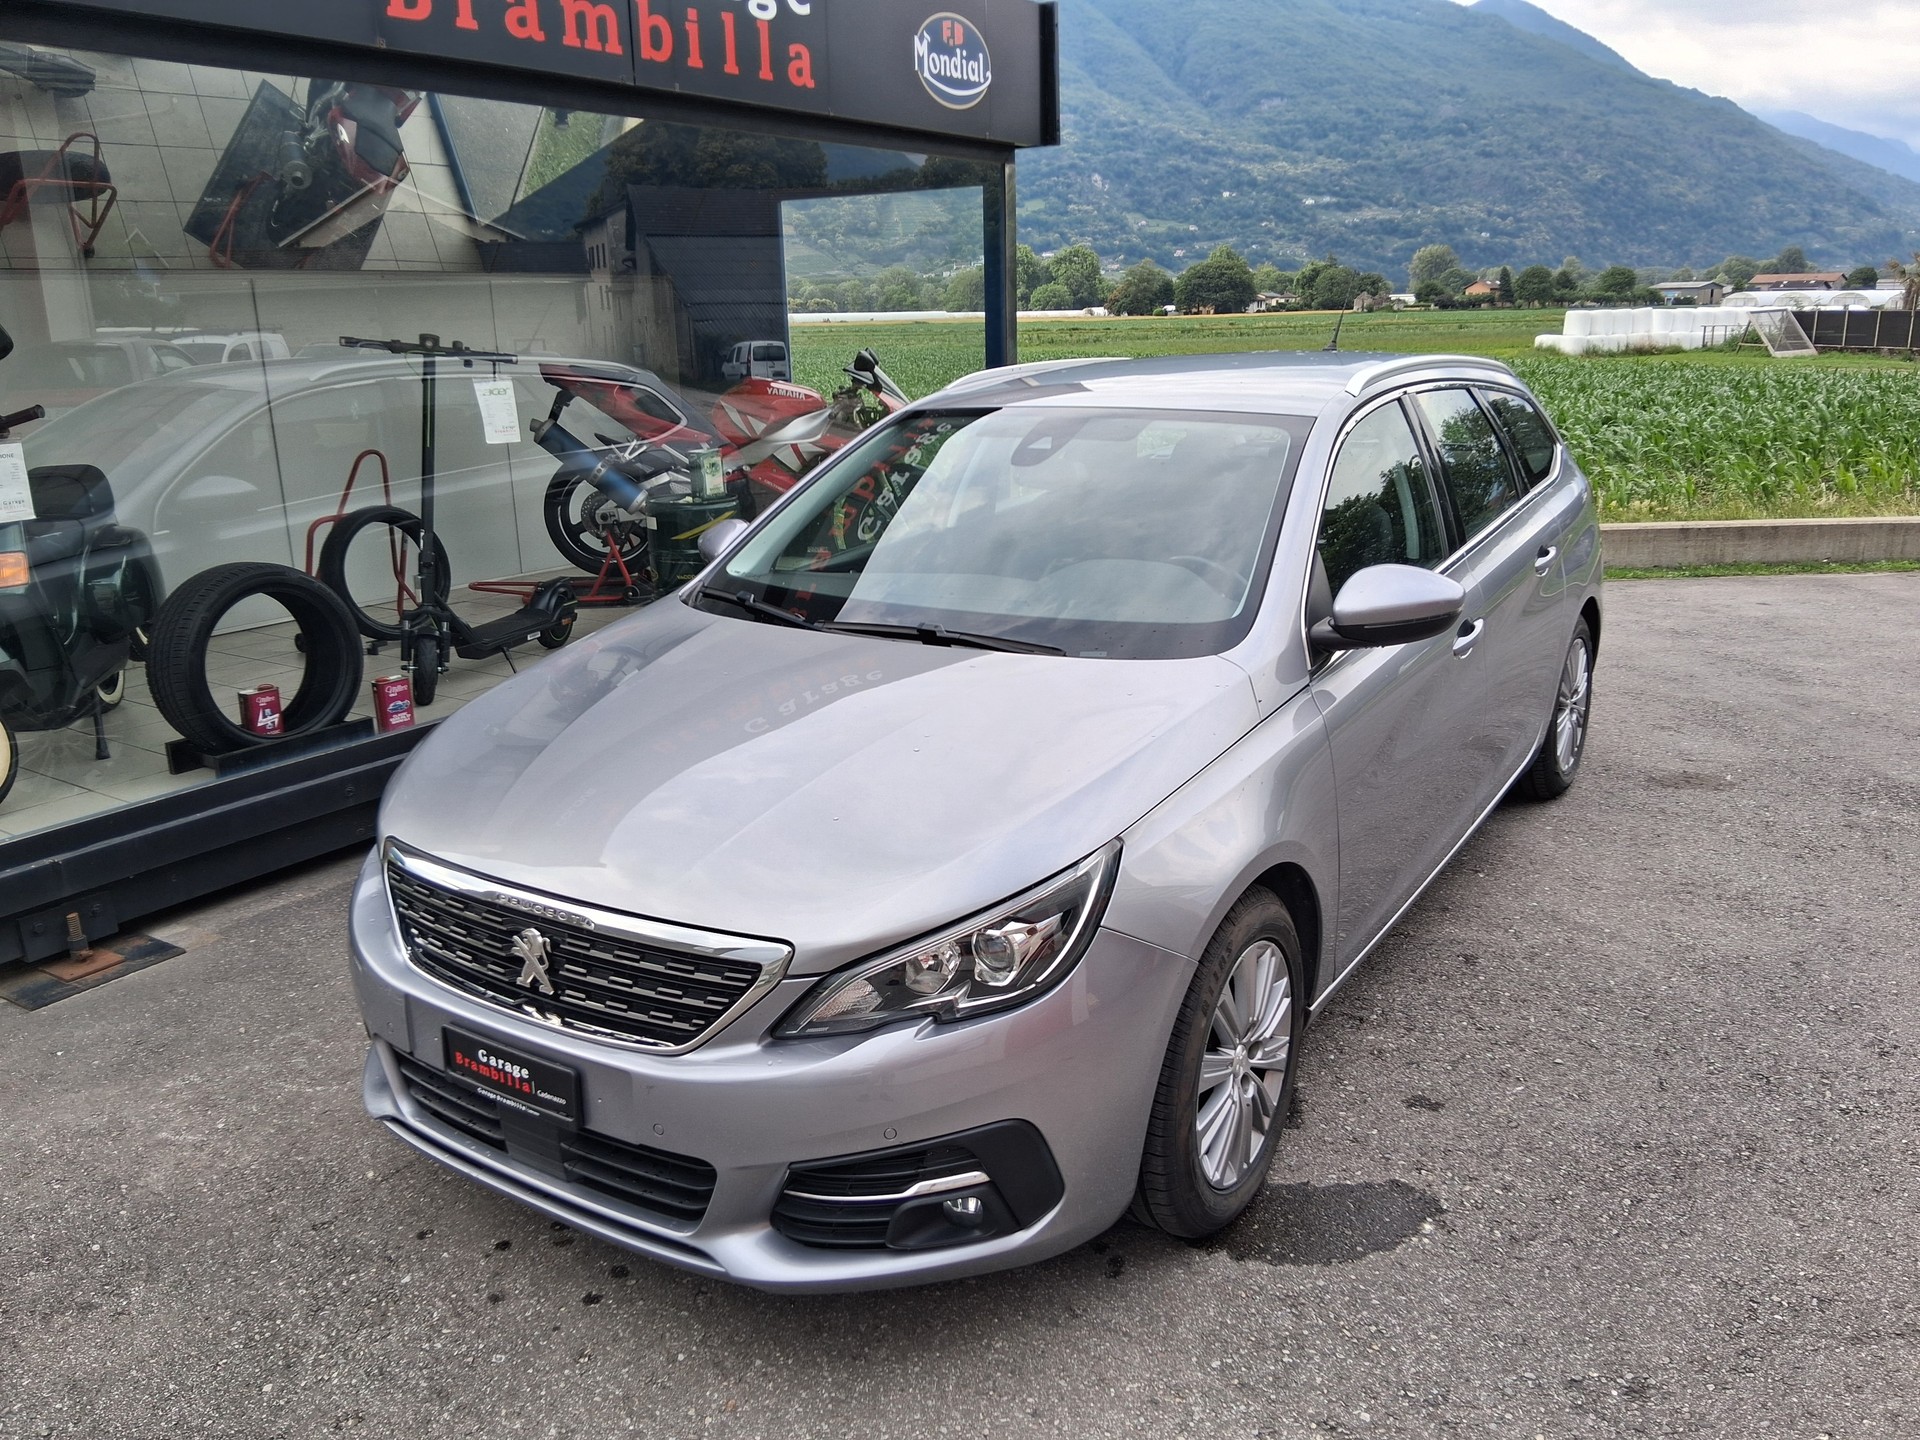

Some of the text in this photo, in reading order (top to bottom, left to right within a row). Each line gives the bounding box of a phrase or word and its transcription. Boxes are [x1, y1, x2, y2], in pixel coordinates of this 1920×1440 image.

[386, 0, 815, 88] rambilla
[914, 29, 991, 96] Mondial
[766, 387, 806, 400] YAMAHA
[497, 893, 580, 924] PEUGEOT
[454, 1052, 531, 1093] Brambilla
[478, 1049, 530, 1078] Garage
